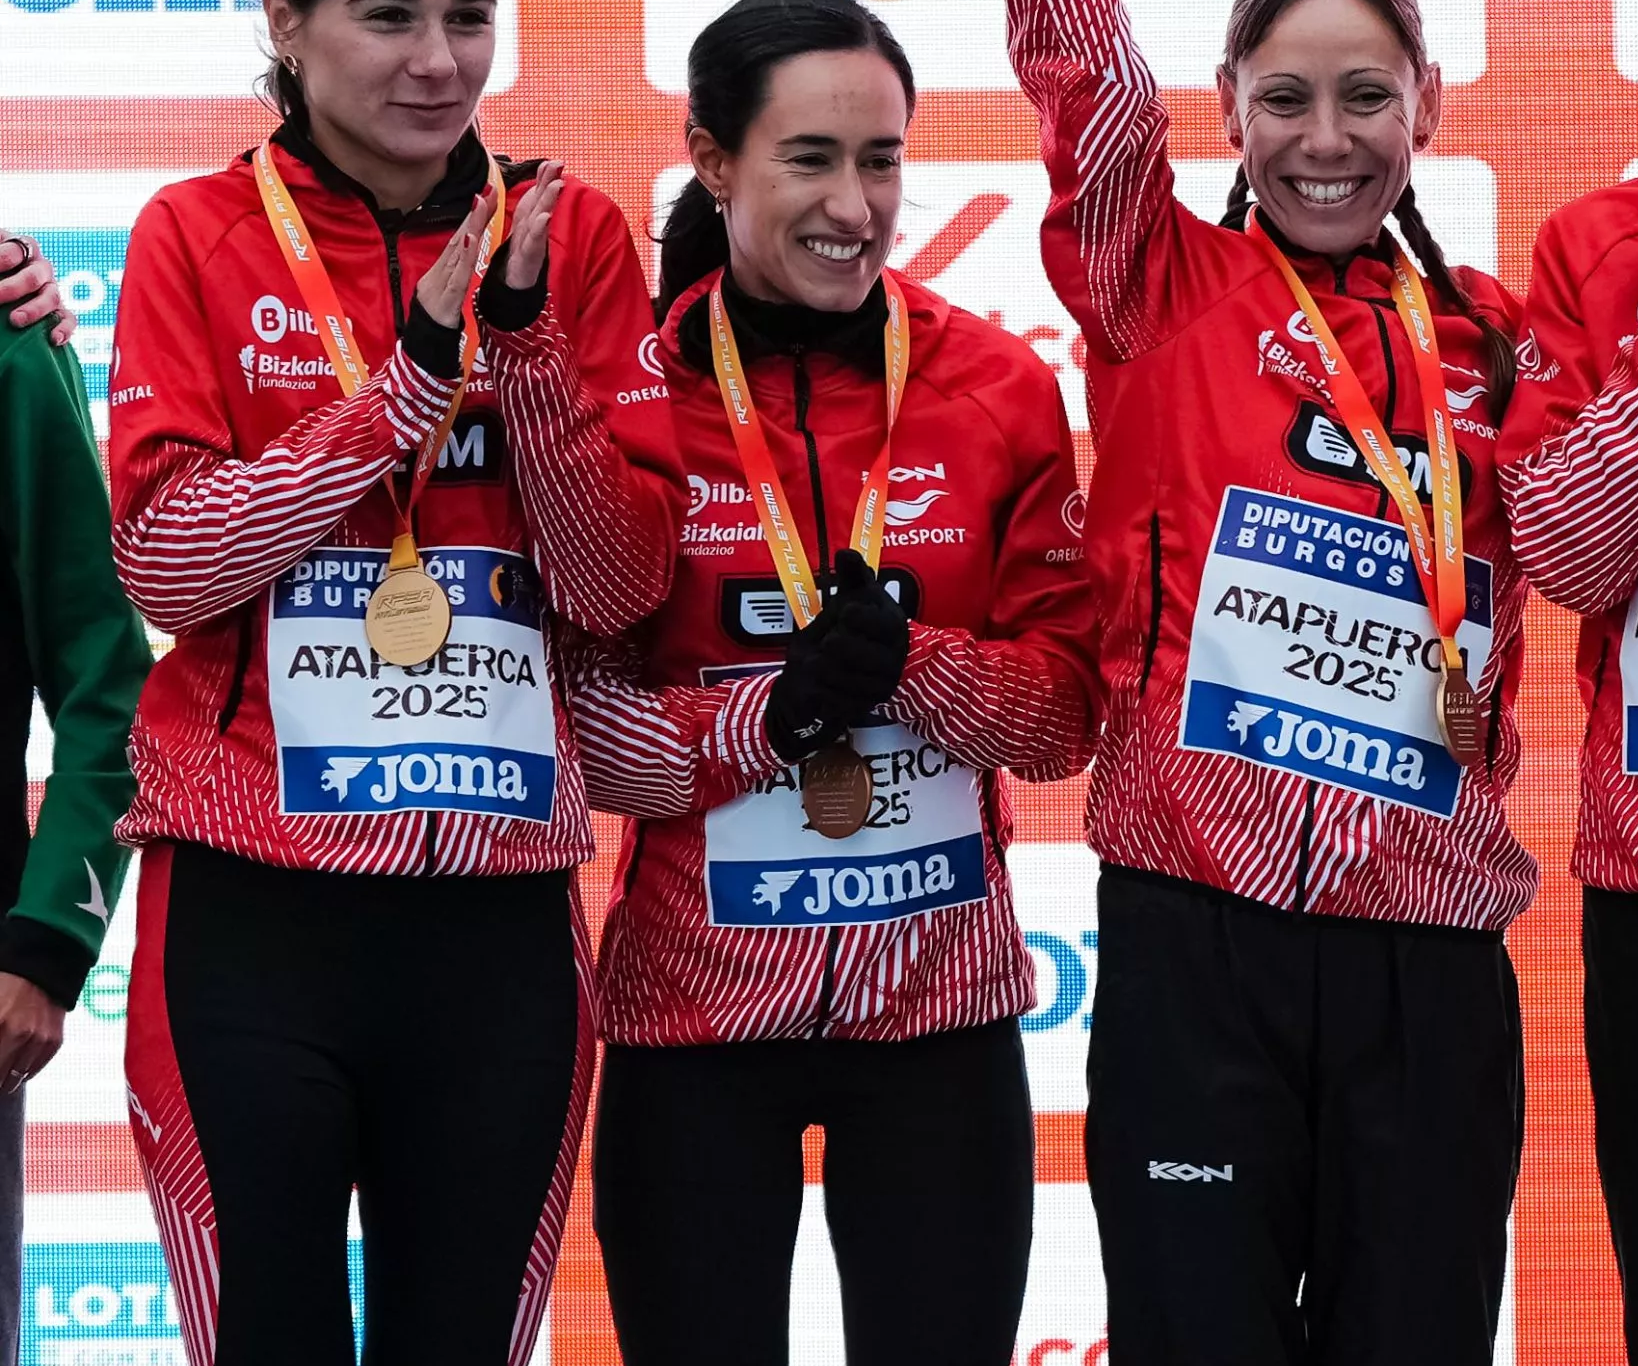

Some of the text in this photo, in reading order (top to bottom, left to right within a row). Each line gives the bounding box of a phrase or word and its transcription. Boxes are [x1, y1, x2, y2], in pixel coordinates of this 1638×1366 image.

[281, 218, 310, 262] RFEA
[712, 290, 749, 425] RFEA ATLETISMO
[1408, 308, 1432, 354] RFEA
[616, 384, 670, 405] OREKA
[1433, 408, 1456, 564] RFEA ATLETISMO
[680, 543, 735, 556] undazioa
[760, 481, 801, 576] ATLETISMO
[881, 528, 966, 548] nteSPORT
[1236, 526, 1405, 586] BURGOS
[1243, 502, 1411, 562] DIPUTACIÓN
[294, 555, 466, 581] DIPUTAÓN
[1283, 643, 1403, 702] 2025
[371, 683, 489, 720] 2025
[1262, 710, 1427, 790] Joma
[369, 752, 528, 804] Joma
[803, 853, 955, 916] Joma
